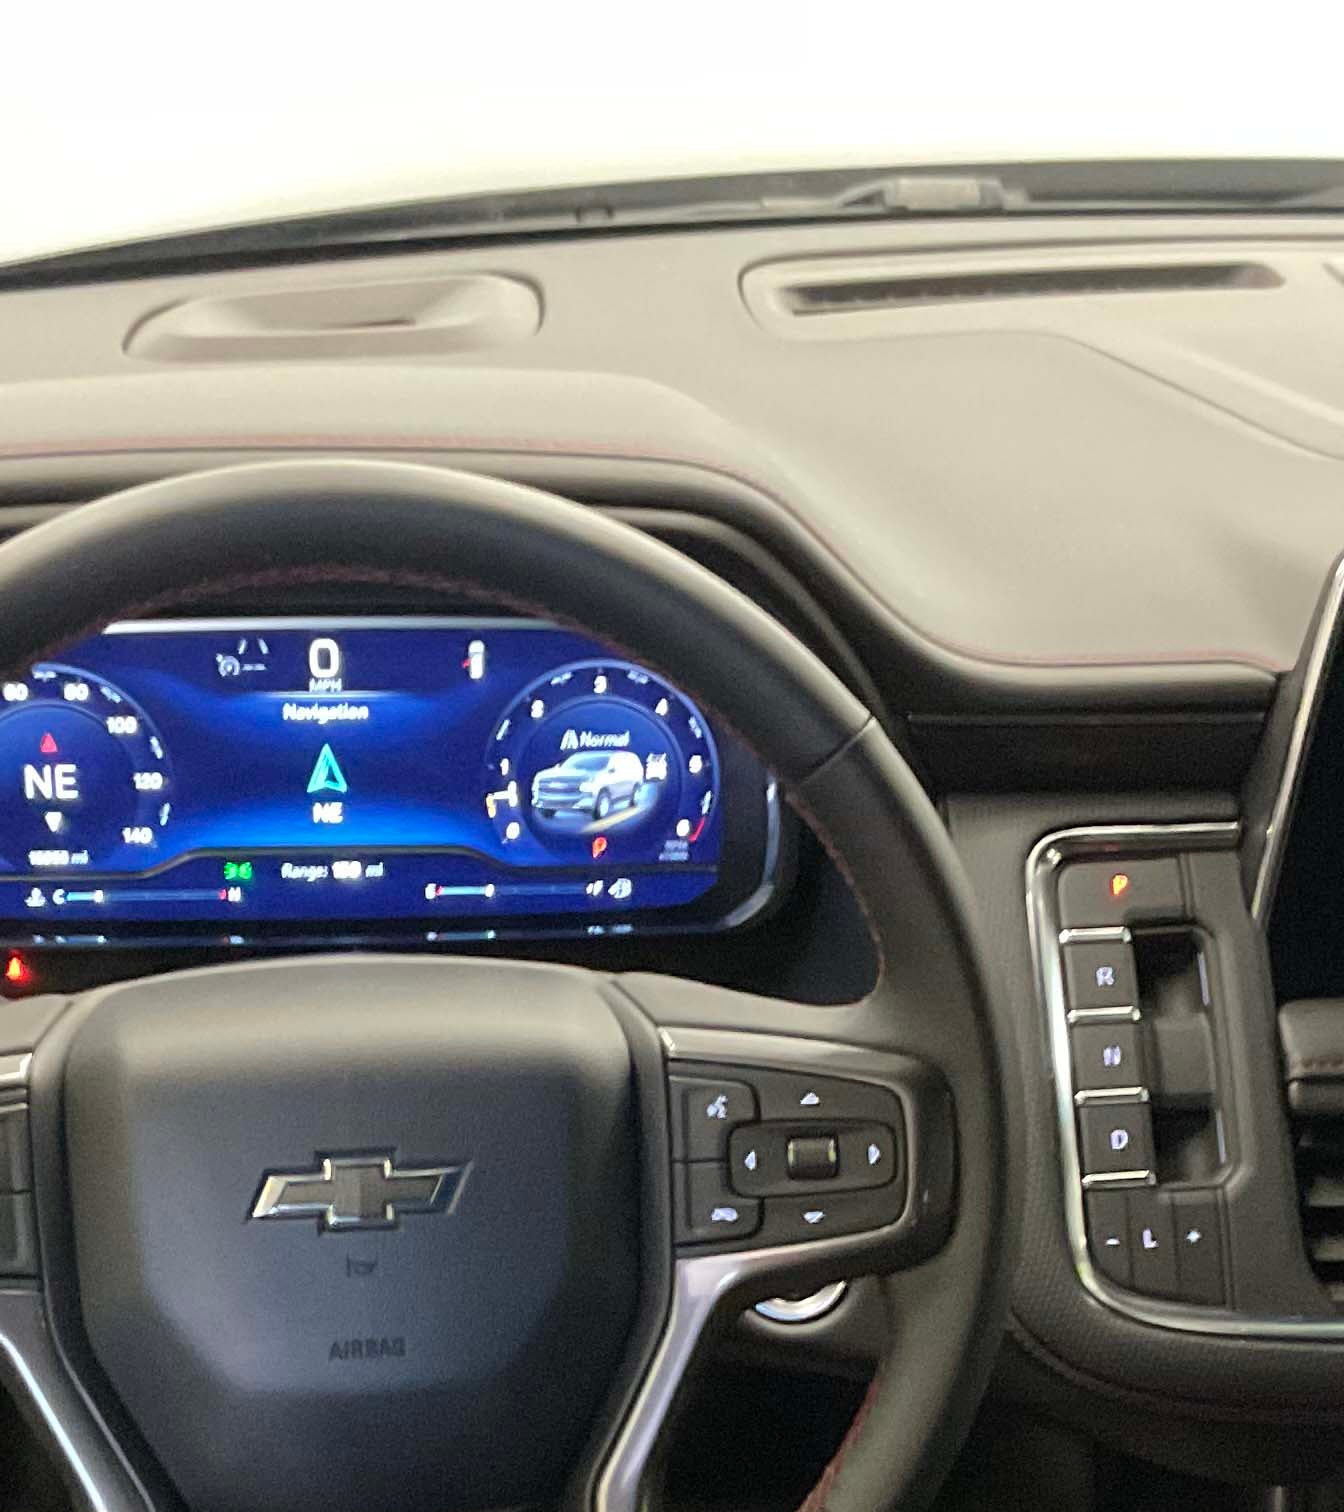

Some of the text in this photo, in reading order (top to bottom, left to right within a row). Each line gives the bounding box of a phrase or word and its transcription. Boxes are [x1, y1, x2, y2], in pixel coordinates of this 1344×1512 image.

[309, 638, 340, 678] 0
[282, 702, 369, 724] Navigation
[106, 715, 138, 734] 100
[579, 730, 630, 748] Normal
[23, 763, 80, 800] NE
[133, 772, 164, 790] 120
[312, 802, 344, 824] NE
[122, 827, 153, 844] 140
[592, 836, 607, 858] P
[281, 862, 328, 882] Range:
[1112, 873, 1129, 895] P
[1095, 966, 1114, 987] R
[1103, 1045, 1122, 1066] N
[1109, 1129, 1129, 1150] D
[1142, 1228, 1158, 1249] L
[328, 1337, 406, 1361] AIRBAG
